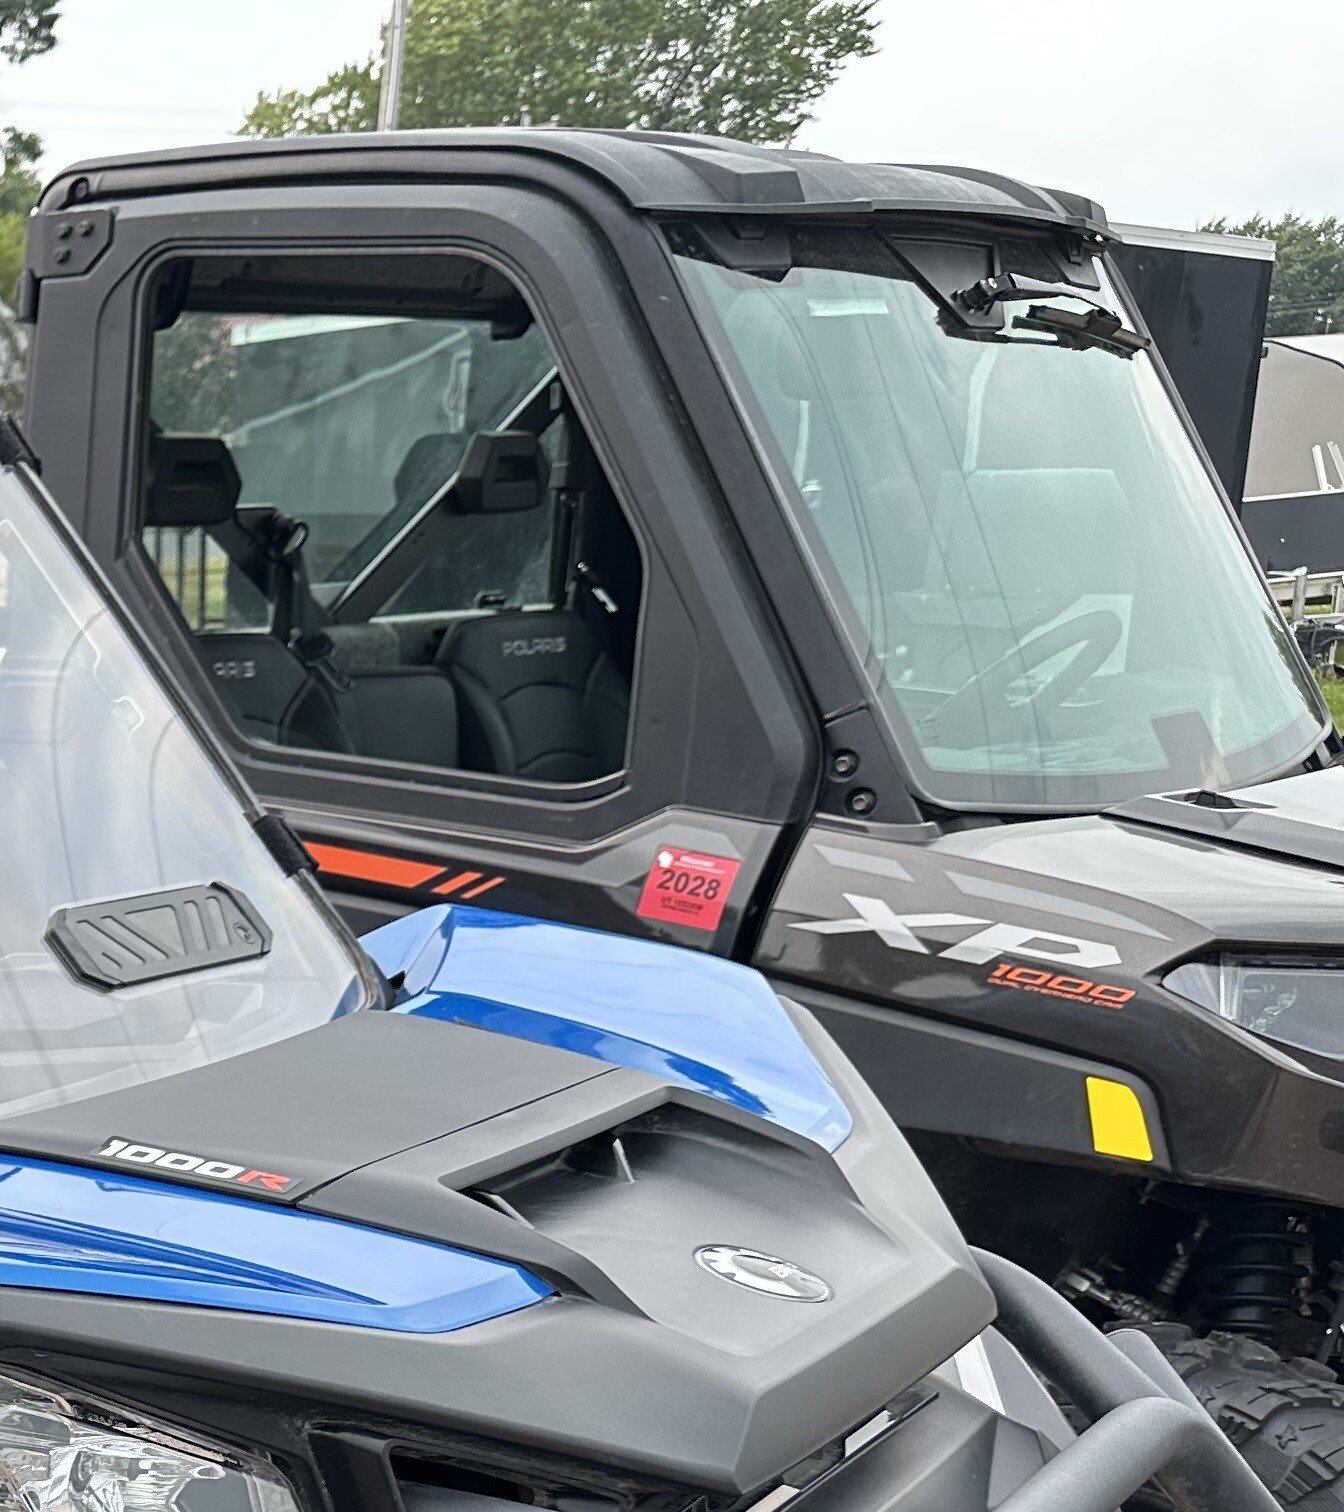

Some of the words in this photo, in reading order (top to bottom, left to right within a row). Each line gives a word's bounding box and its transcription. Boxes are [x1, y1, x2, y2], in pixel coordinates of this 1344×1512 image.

[657, 868, 721, 900] 2028
[786, 893, 1121, 968] XP
[992, 963, 1136, 1003] 1000
[98, 1139, 291, 1191] 1000R
